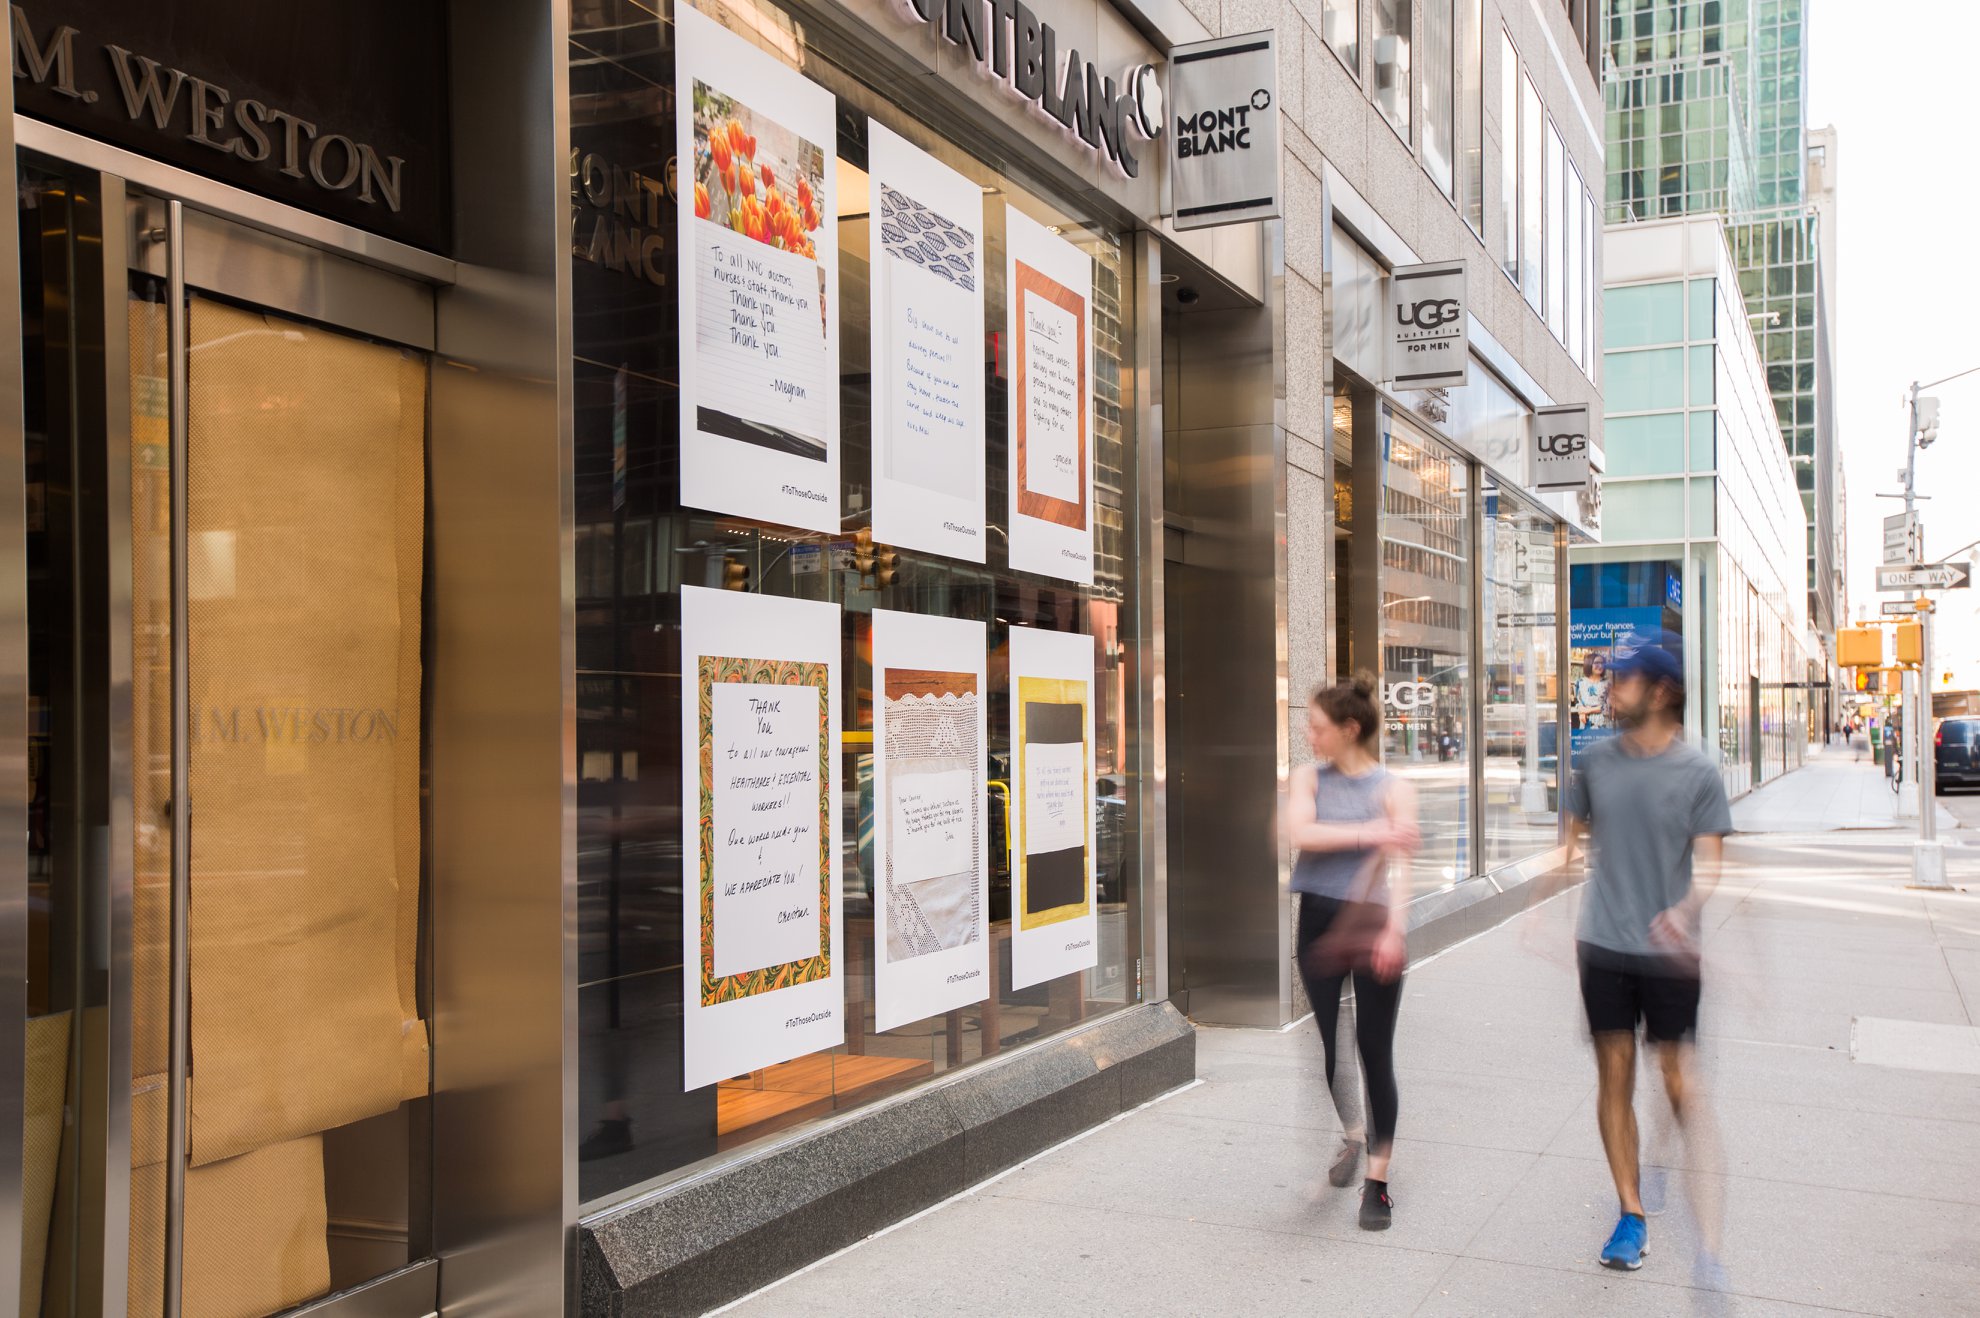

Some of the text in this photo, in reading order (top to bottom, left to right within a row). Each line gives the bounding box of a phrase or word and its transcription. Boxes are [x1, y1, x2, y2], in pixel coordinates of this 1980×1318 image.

[105, 44, 405, 212] WESTON
[1177, 105, 1250, 137] MONT
[1177, 127, 1251, 158] BLANC
[711, 246, 723, 262] To
[730, 254, 743, 268] all
[747, 258, 763, 276] NYC
[714, 266, 741, 285] nurses
[770, 287, 794, 305] thank
[730, 289, 758, 309] Thank
[730, 309, 757, 327] Thank
[1028, 311, 1046, 332] Thank
[1397, 299, 1460, 330] UGG
[729, 327, 759, 349] Thank
[1397, 327, 1460, 339] australia
[1407, 341, 1450, 352] FOR MEN
[1538, 433, 1586, 457] UGG
[782, 485, 827, 503] #ToThoseOutside
[943, 521, 976, 536] #ToThoseOutside
[1062, 549, 1087, 561] #ToThoseOutside
[1889, 571, 1957, 585] ONE WAY
[1583, 632, 1599, 641] your
[1587, 624, 1604, 634] your
[1605, 622, 1636, 631] finances.
[749, 698, 781, 715] THANK
[256, 706, 400, 743] WESTON
[1385, 723, 1427, 731] FOR MEN
[727, 741, 739, 759] to
[743, 747, 757, 759] all
[760, 749, 772, 758] our
[724, 882, 737, 897] WE
[1065, 940, 1090, 951] #ToThoseOutside
[946, 969, 980, 985] #ToThoseOutside
[785, 1009, 831, 1029] #ToThoseOutside
